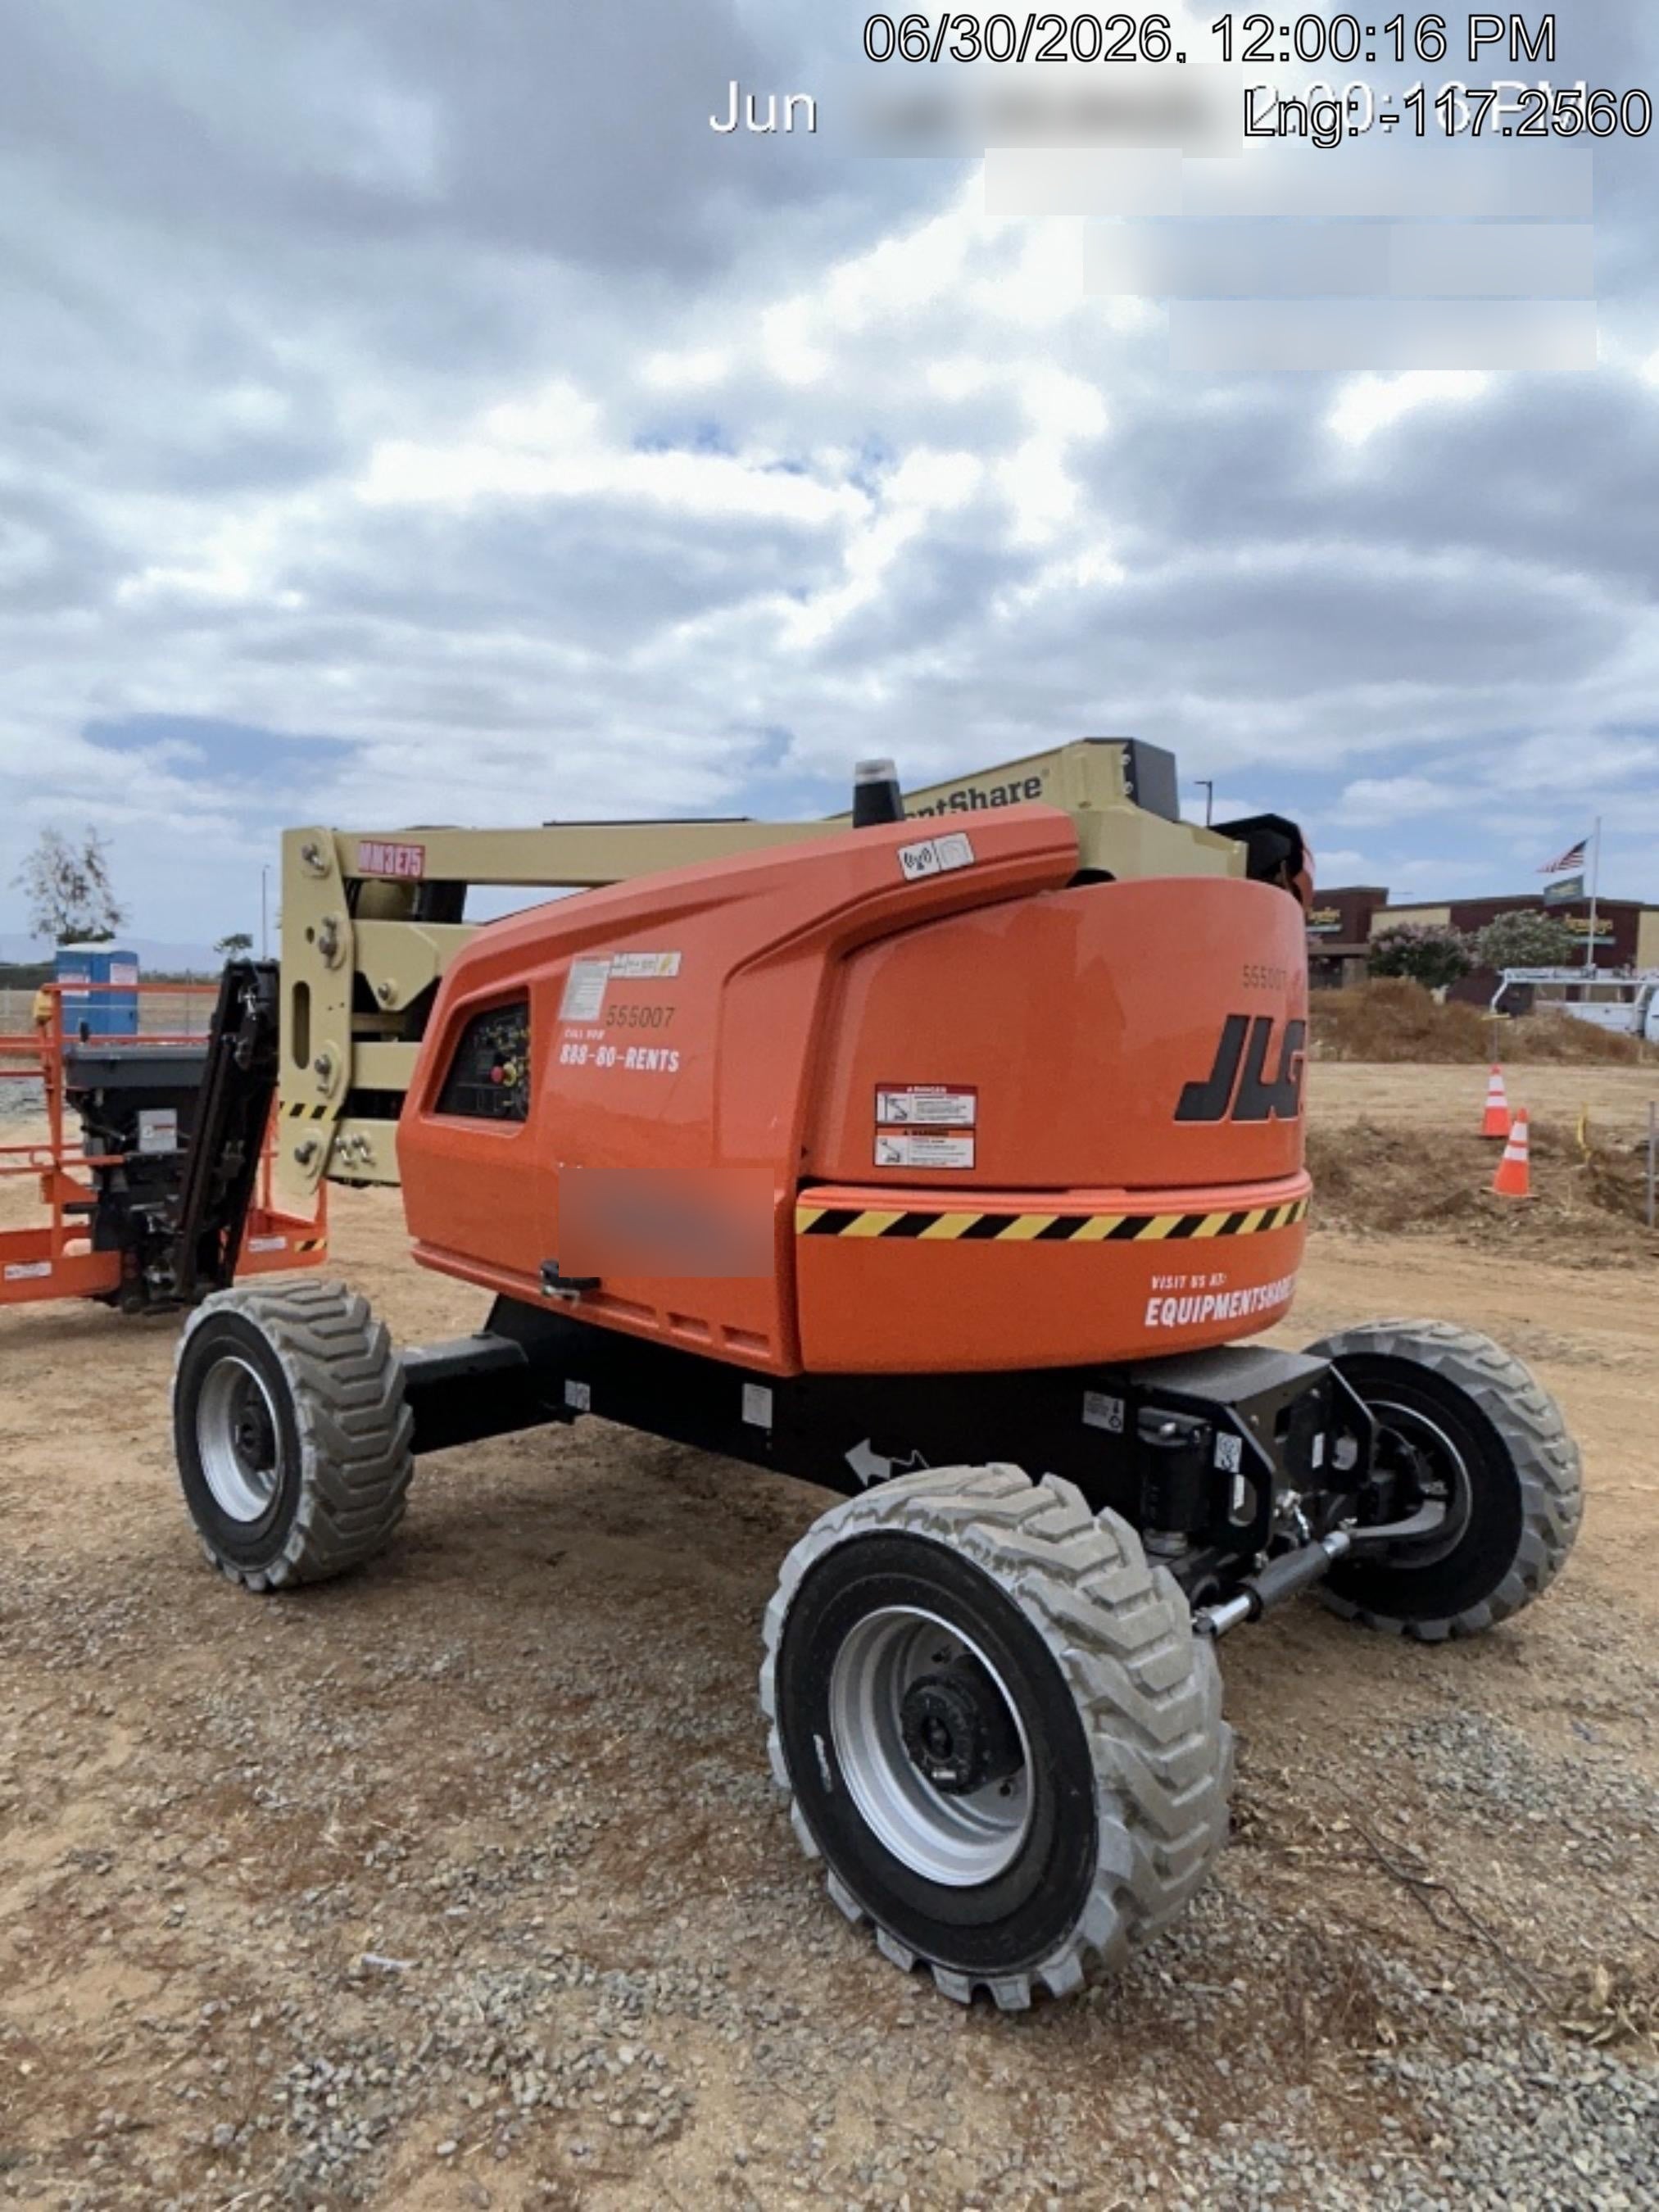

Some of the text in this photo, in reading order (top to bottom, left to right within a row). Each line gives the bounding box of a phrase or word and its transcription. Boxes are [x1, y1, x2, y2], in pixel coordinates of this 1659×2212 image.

[606, 1004, 675, 1028] 555007
[1173, 1014, 1307, 1122] JLG
[1151, 1275, 1187, 1290] VISIT
